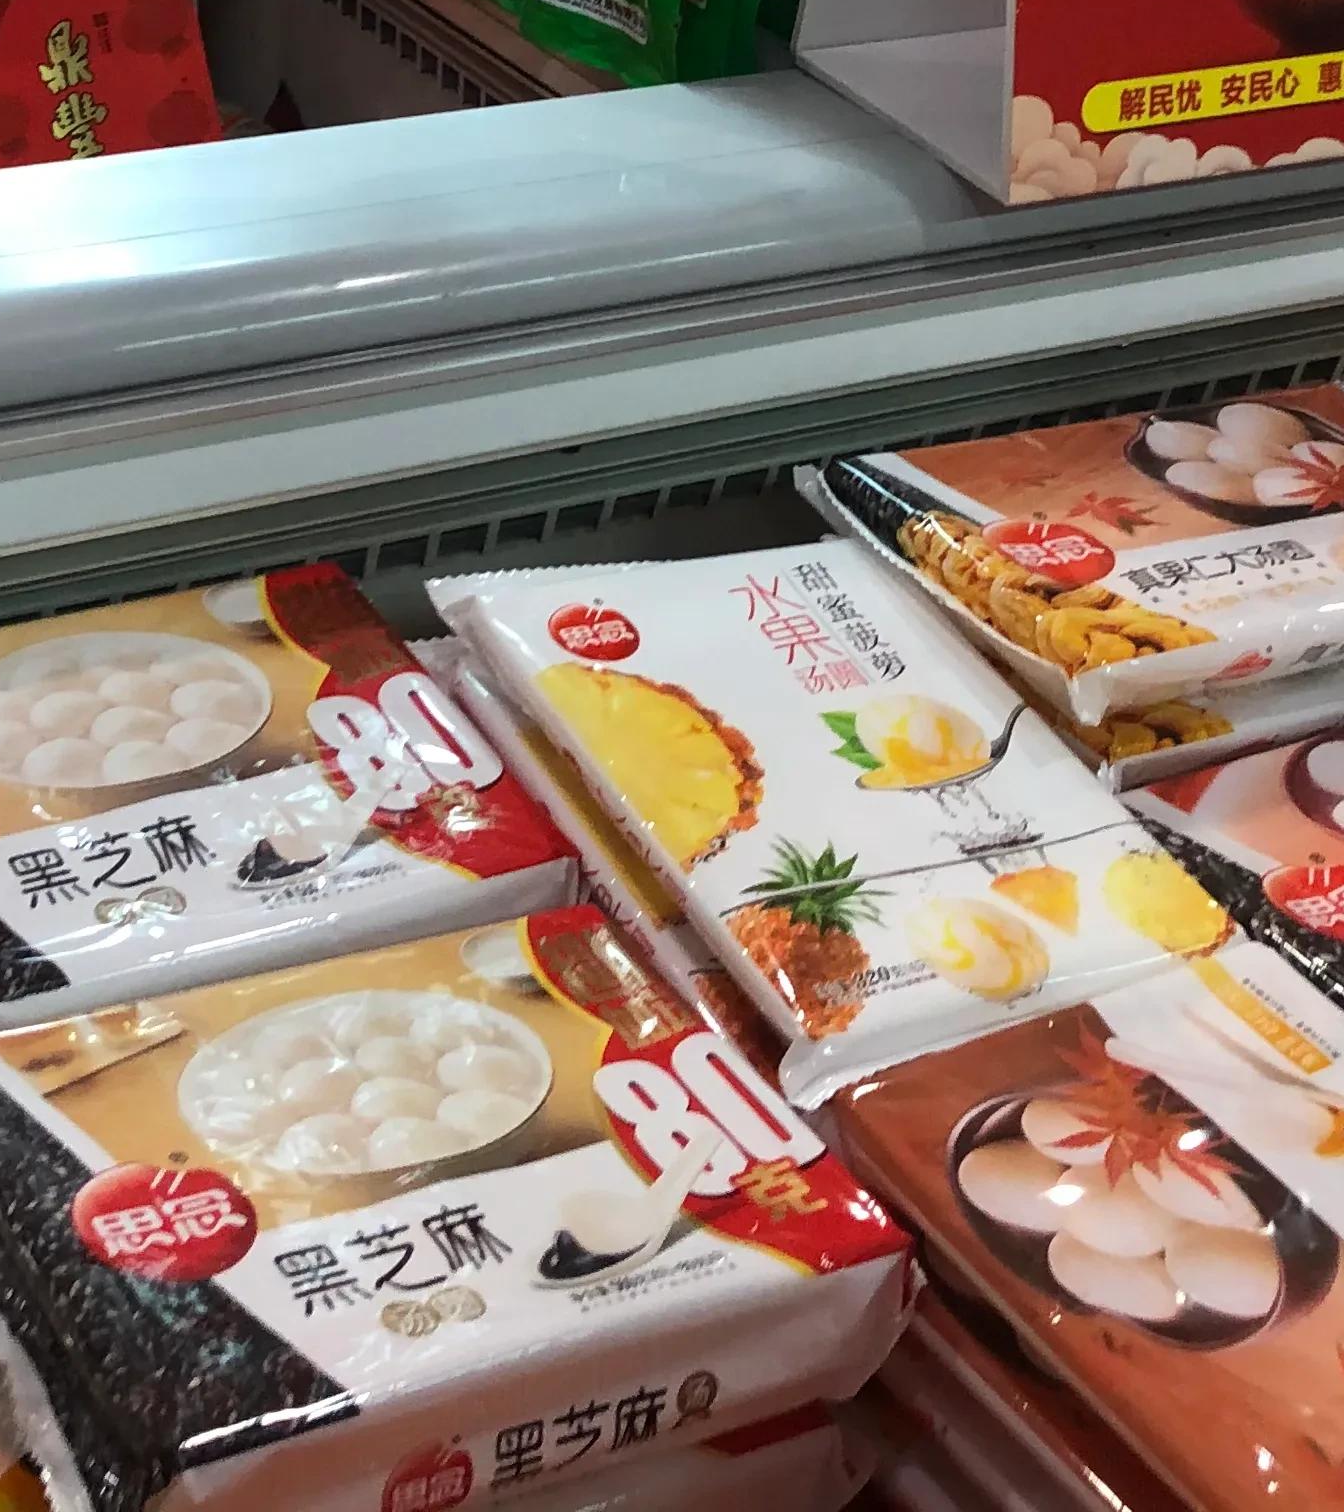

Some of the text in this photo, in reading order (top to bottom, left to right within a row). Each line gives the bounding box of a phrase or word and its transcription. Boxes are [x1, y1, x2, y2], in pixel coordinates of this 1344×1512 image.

[1119, 81, 1202, 122] 解民忧
[1221, 66, 1301, 107] 安民心
[793, 561, 907, 682] 甜蜜菠萝
[8, 814, 217, 909] 黑芝麻
[593, 1031, 828, 1197] 80
[90, 1189, 248, 1256] 思念
[273, 1202, 512, 1318] 黑芝麻
[490, 1385, 669, 1490] 黑芝麻
